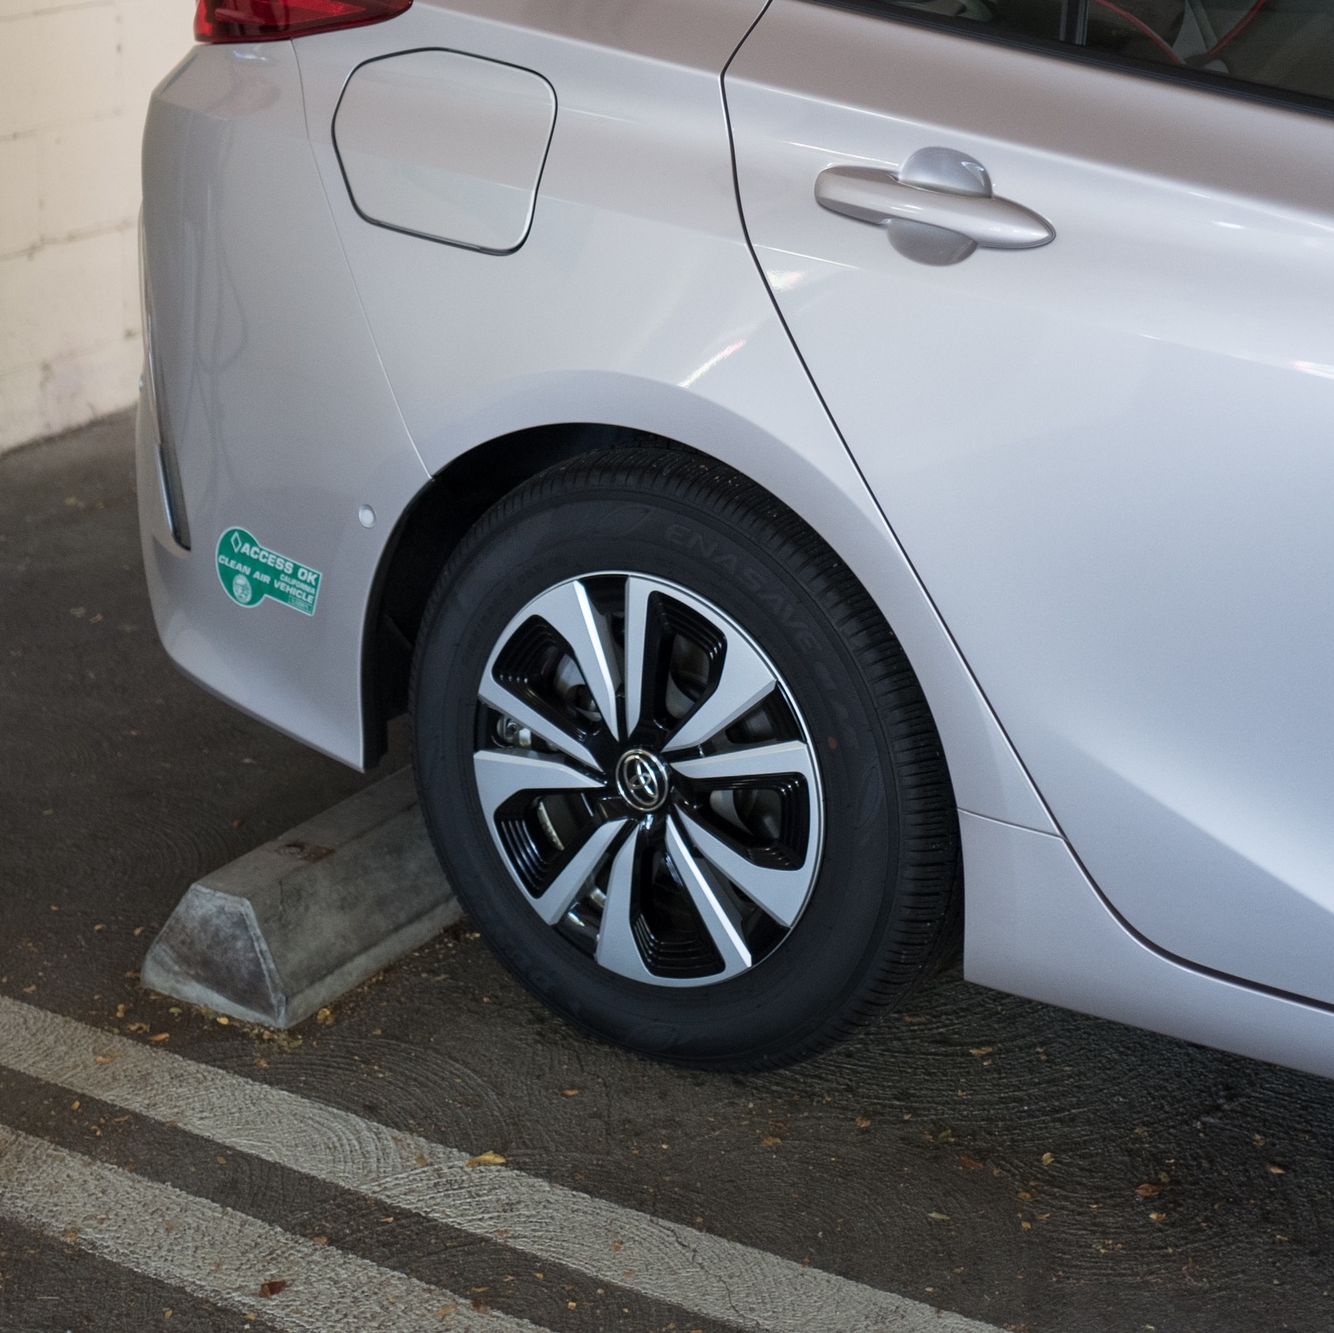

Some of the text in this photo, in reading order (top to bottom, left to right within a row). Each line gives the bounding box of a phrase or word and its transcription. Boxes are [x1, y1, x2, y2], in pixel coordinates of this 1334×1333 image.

[218, 554, 251, 576] CLEAN
[252, 571, 271, 584] AIR
[273, 579, 314, 604] VEHICLE
[240, 543, 318, 586] ACCESS OK
